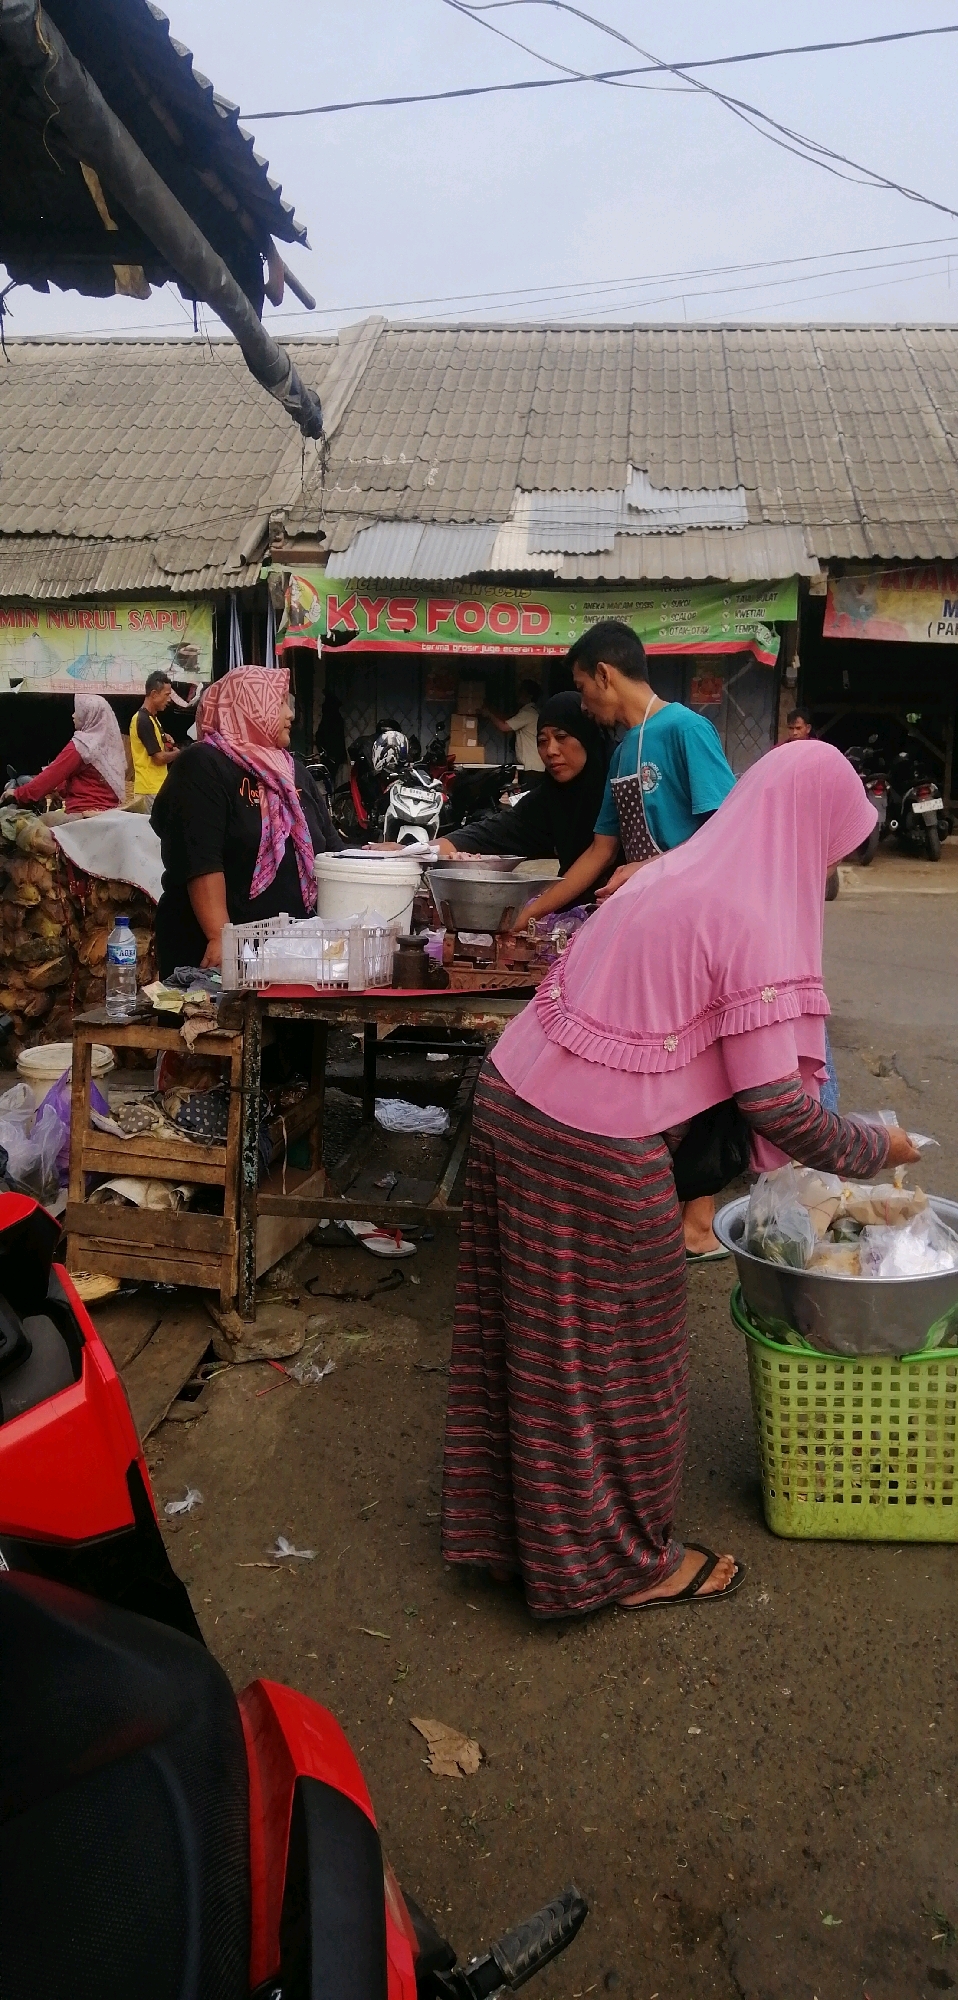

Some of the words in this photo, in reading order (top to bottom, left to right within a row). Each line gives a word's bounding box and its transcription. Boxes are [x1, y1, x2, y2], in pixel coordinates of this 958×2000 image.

[453, 582, 483, 596] DAN
[484, 586, 532, 599] SOSIS
[583, 602, 605, 610] ANEKA
[326, 593, 420, 634] KYS
[426, 598, 552, 636] FOOD
[734, 608, 766, 619] KWETIAU
[46, 609, 122, 631] NURUL
[128, 610, 187, 632] SAPU
[669, 625, 711, 636] OTAK-OTAK
[421, 643, 449, 651] terima
[452, 644, 479, 653] grosir
